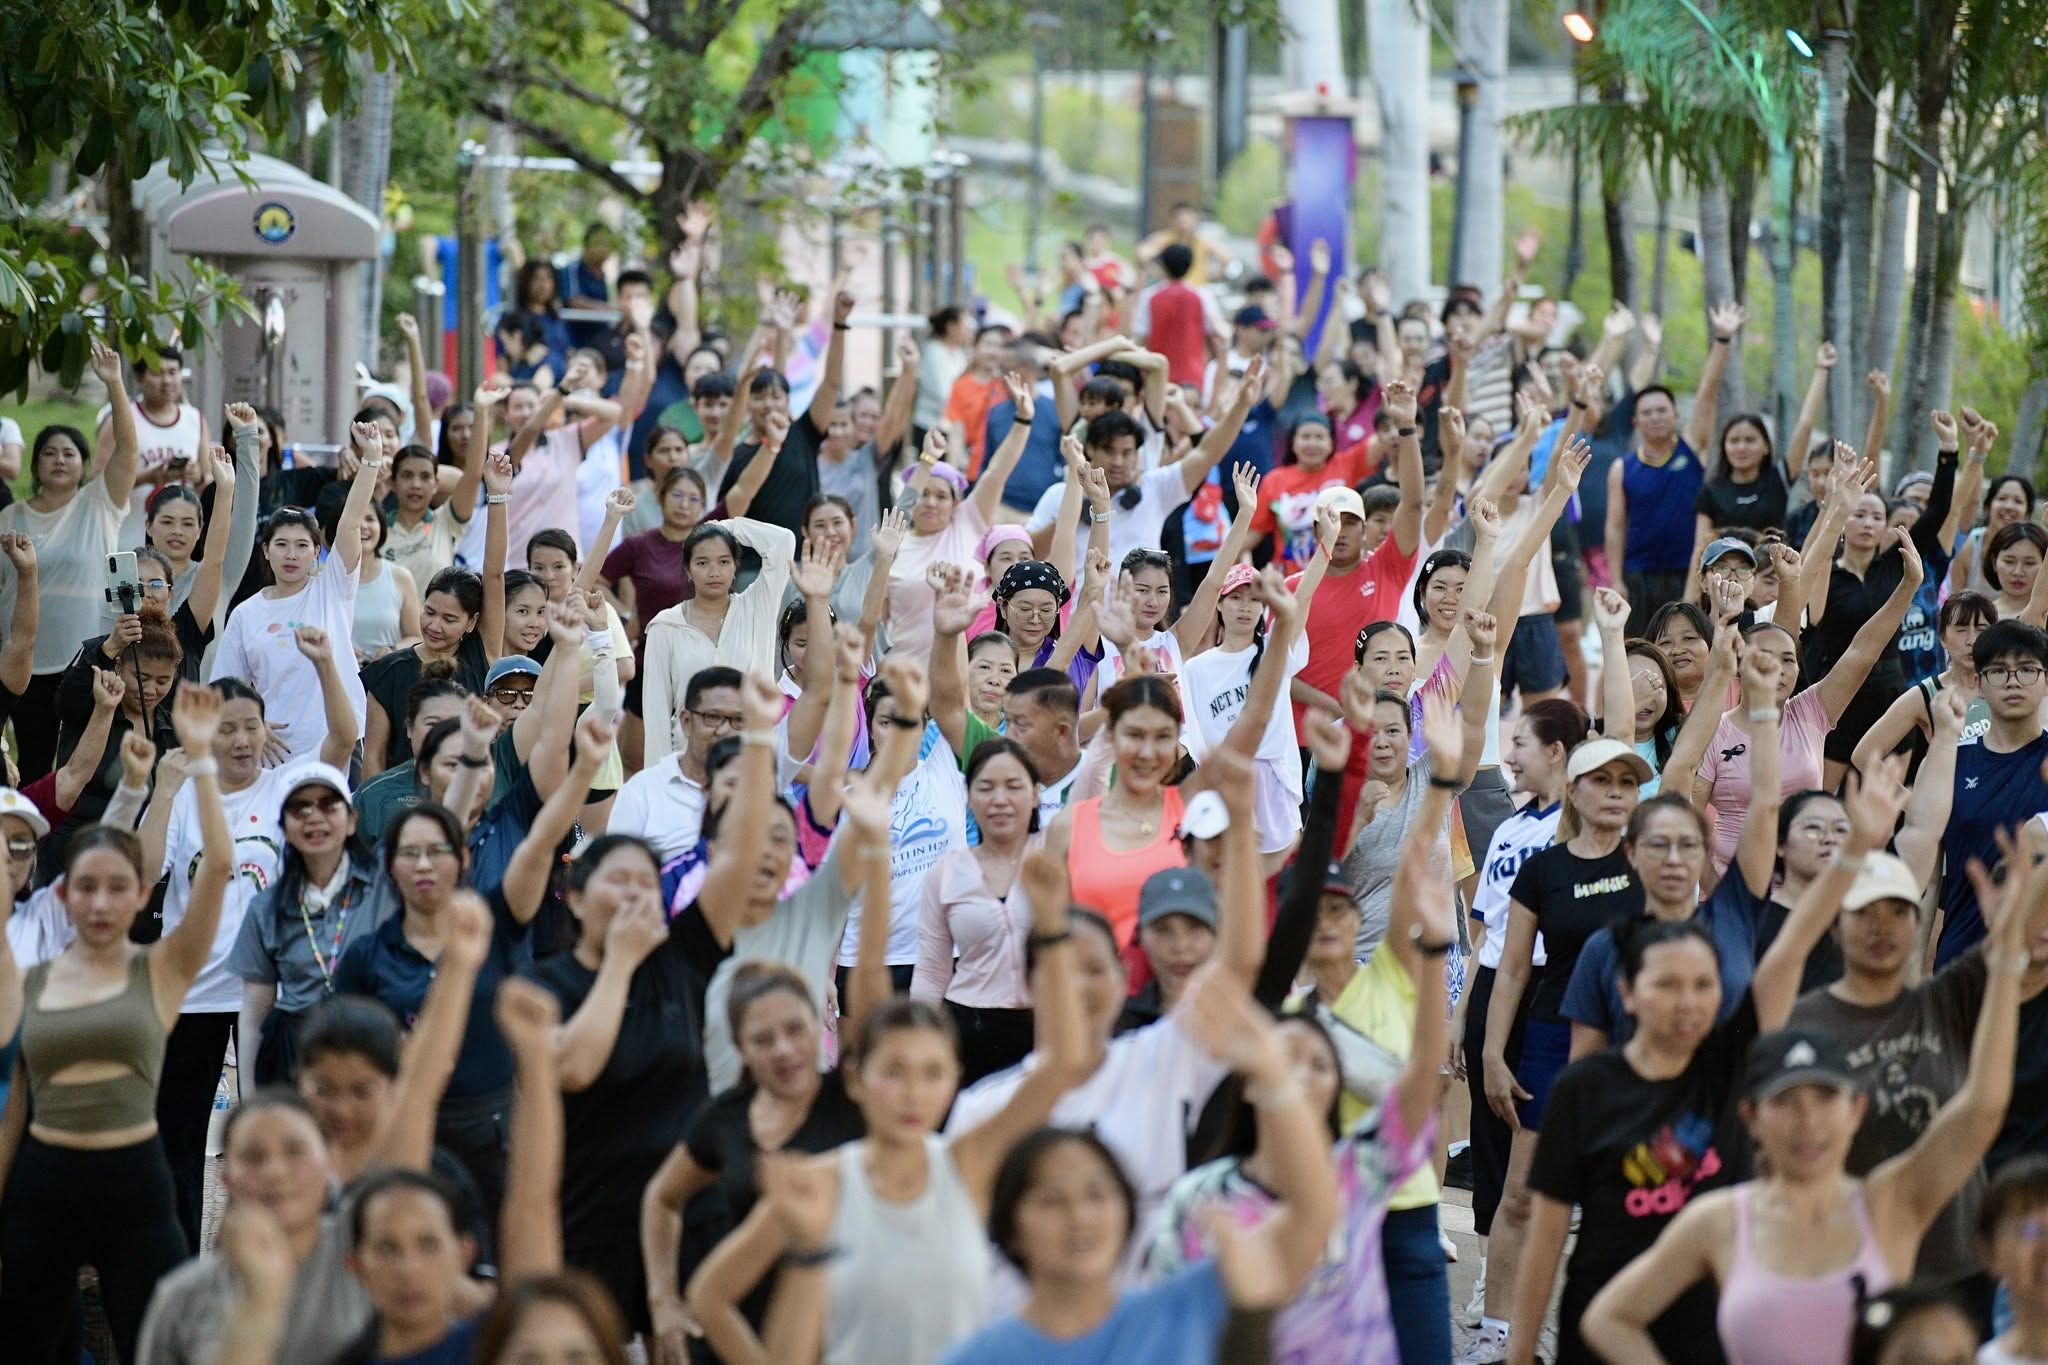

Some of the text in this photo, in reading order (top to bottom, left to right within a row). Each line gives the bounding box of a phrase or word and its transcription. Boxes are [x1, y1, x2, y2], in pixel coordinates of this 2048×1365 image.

[1898, 629, 1935, 651] ang
[1210, 690, 1232, 718] NCT
[1959, 718, 1991, 742] JORD
[153, 911, 163, 920] Ru
